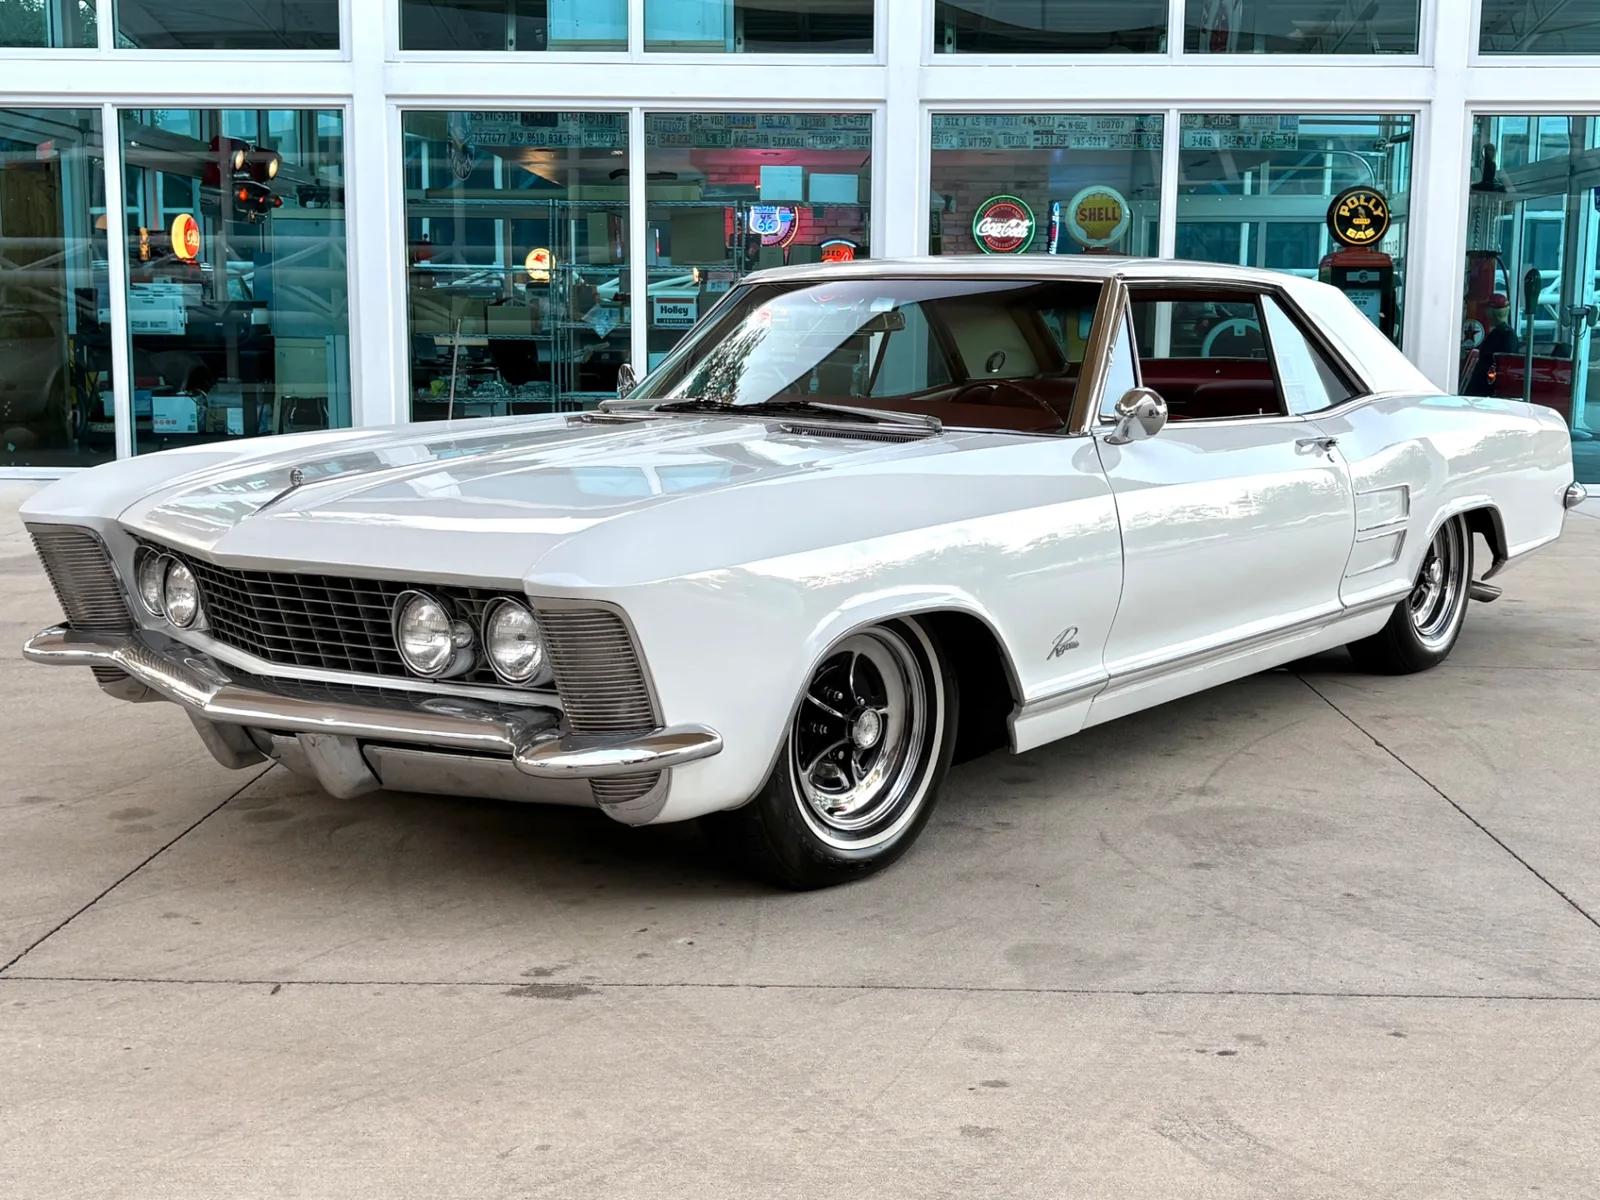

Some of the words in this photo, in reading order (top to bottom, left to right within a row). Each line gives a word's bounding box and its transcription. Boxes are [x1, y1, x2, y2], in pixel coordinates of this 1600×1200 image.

[1339, 194, 1384, 217] POLLY
[1079, 207, 1118, 222] SHELL
[757, 220, 773, 231] 66
[1346, 227, 1375, 239] GAS
[660, 305, 689, 317] Holley
